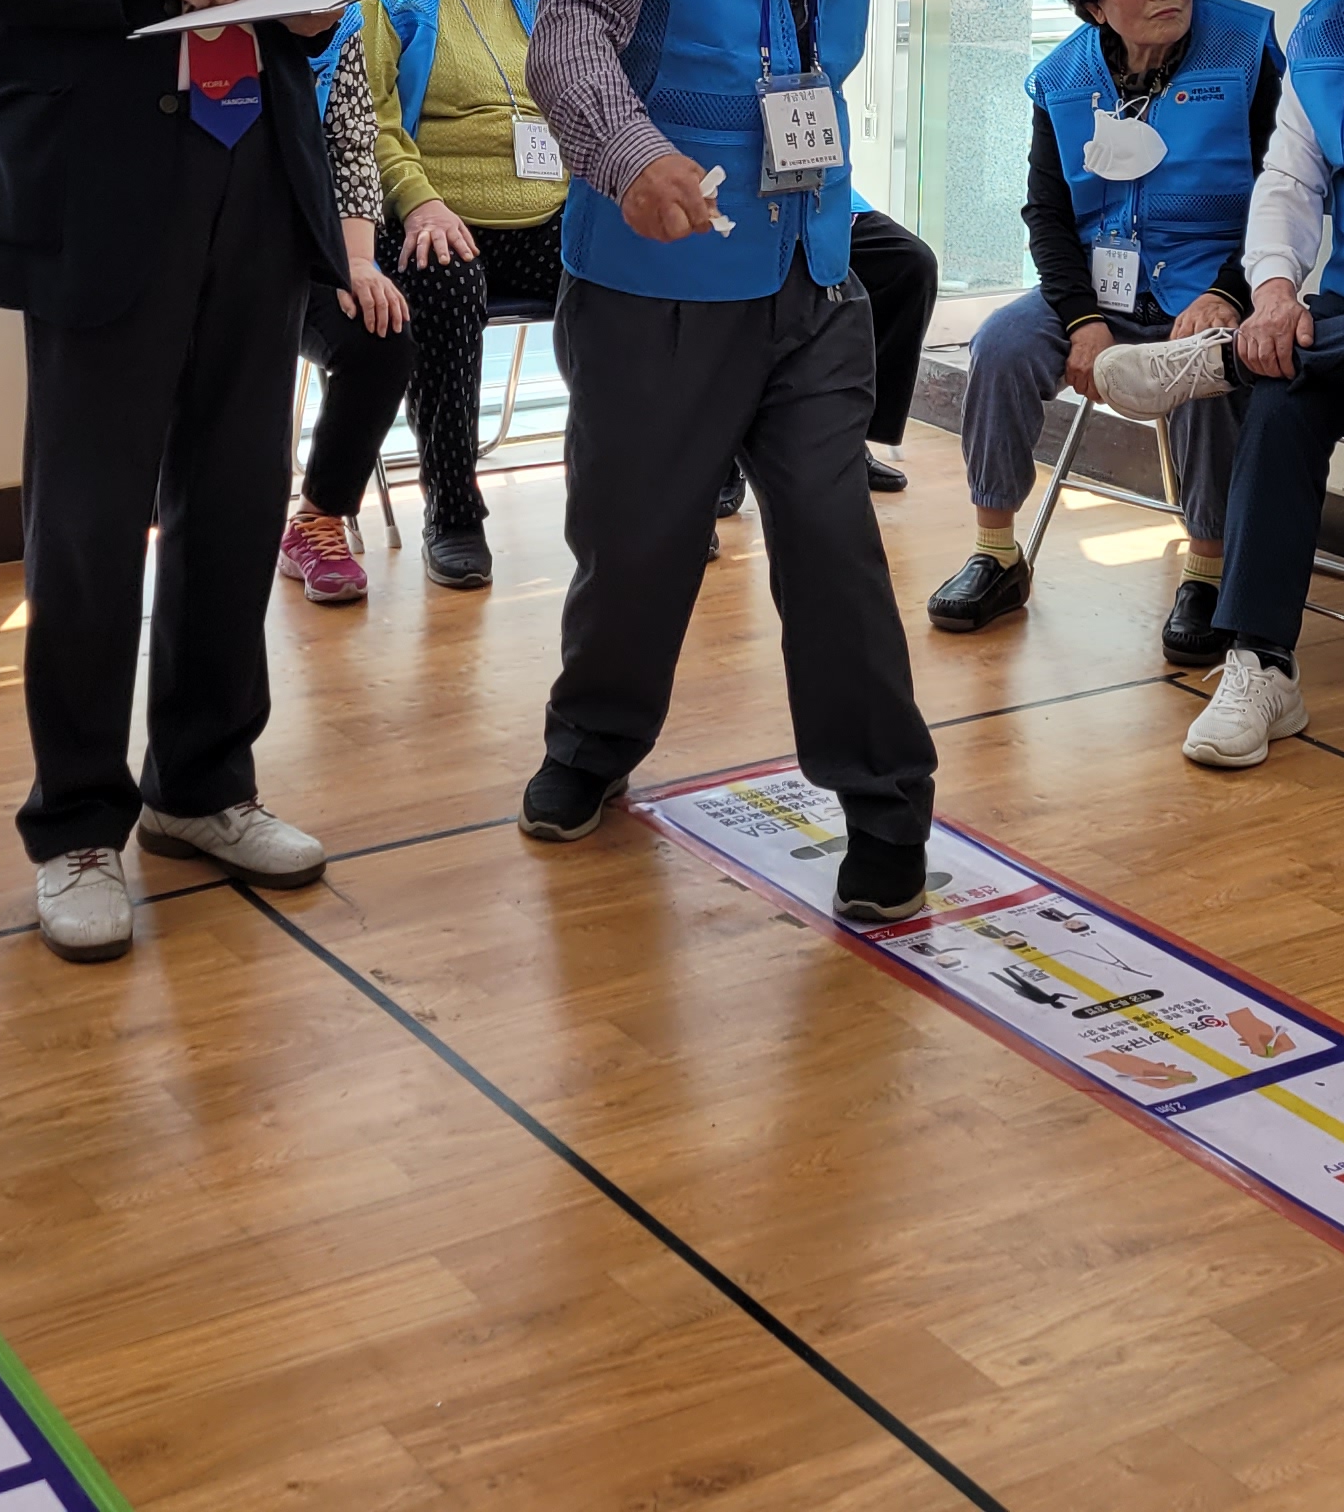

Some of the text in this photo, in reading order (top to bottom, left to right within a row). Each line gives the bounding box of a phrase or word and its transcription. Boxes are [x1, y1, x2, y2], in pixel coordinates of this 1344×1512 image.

[202, 79, 231, 88] KOREA
[791, 108, 817, 127] 4 번
[530, 136, 537, 150] 5
[1106, 261, 1115, 277] 2
[1099, 278, 1108, 293] 김
[1124, 282, 1132, 297] 수
[735, 810, 831, 838] TAFISA
